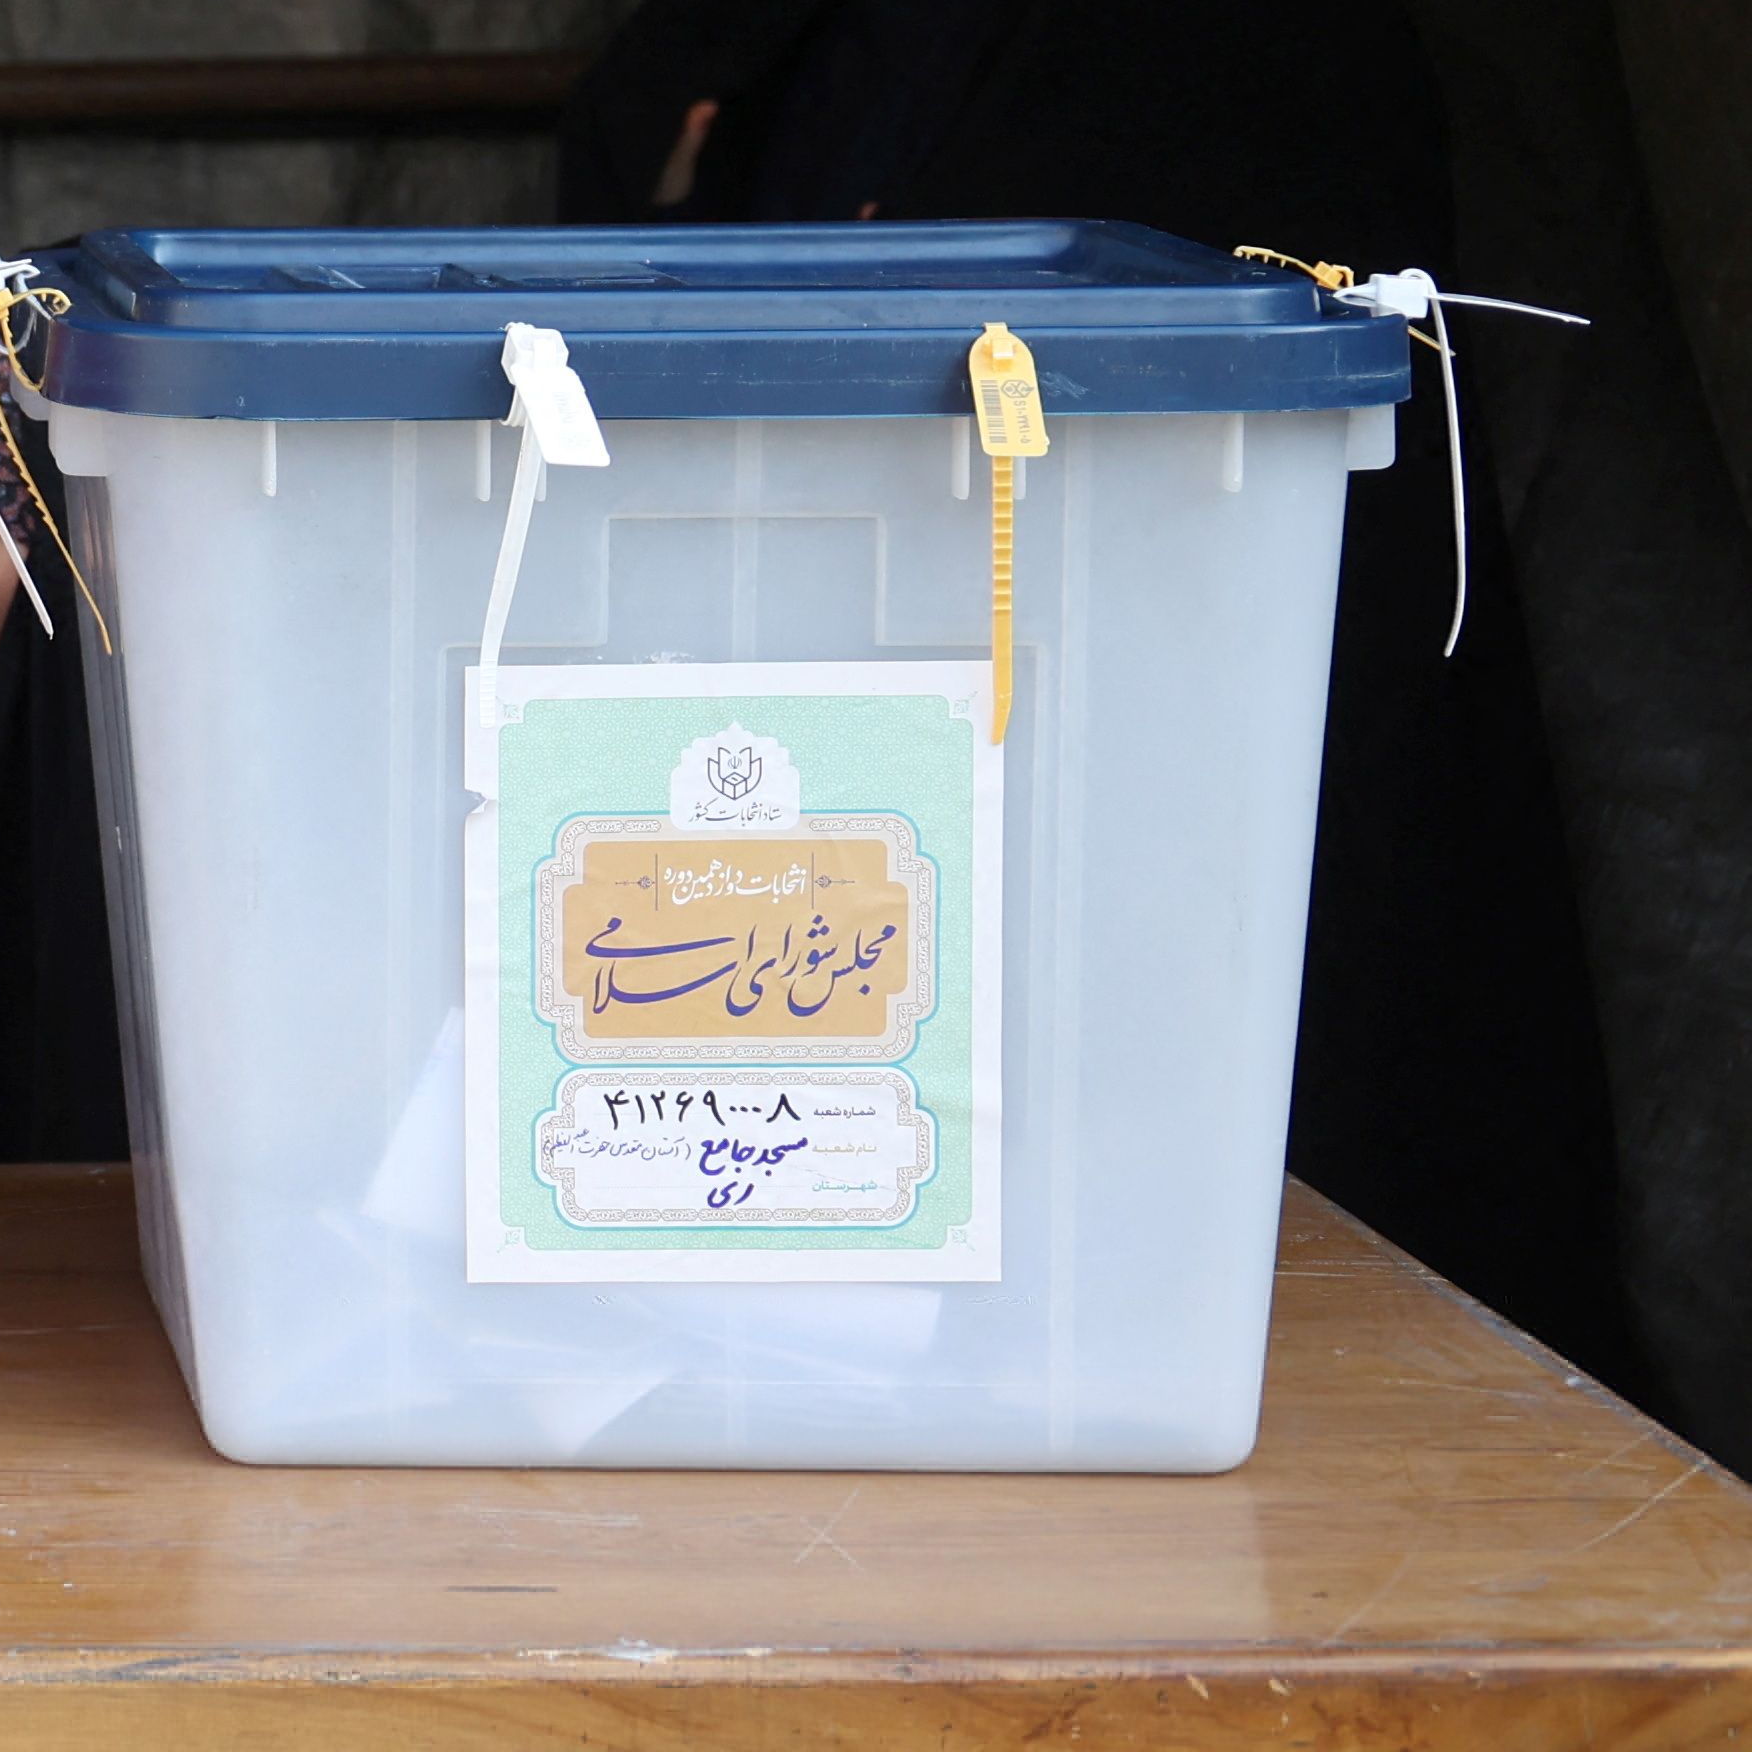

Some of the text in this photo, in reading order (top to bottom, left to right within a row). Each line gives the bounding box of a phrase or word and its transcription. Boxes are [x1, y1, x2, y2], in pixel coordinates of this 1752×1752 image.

[688, 798, 782, 827] ستاد انتخابات کشور
[663, 859, 808, 906] انتخابات دوازدهمین دوره
[584, 914, 898, 1018] مجلس شورای اسلامی
[813, 1106, 877, 1119] شماره شعبه
[698, 1137, 754, 1176] جامع
[751, 1137, 809, 1177] مسجد
[812, 1142, 877, 1157] نام شعبه
[706, 1181, 755, 1209] ری
[811, 1179, 878, 1192] شهرستان
